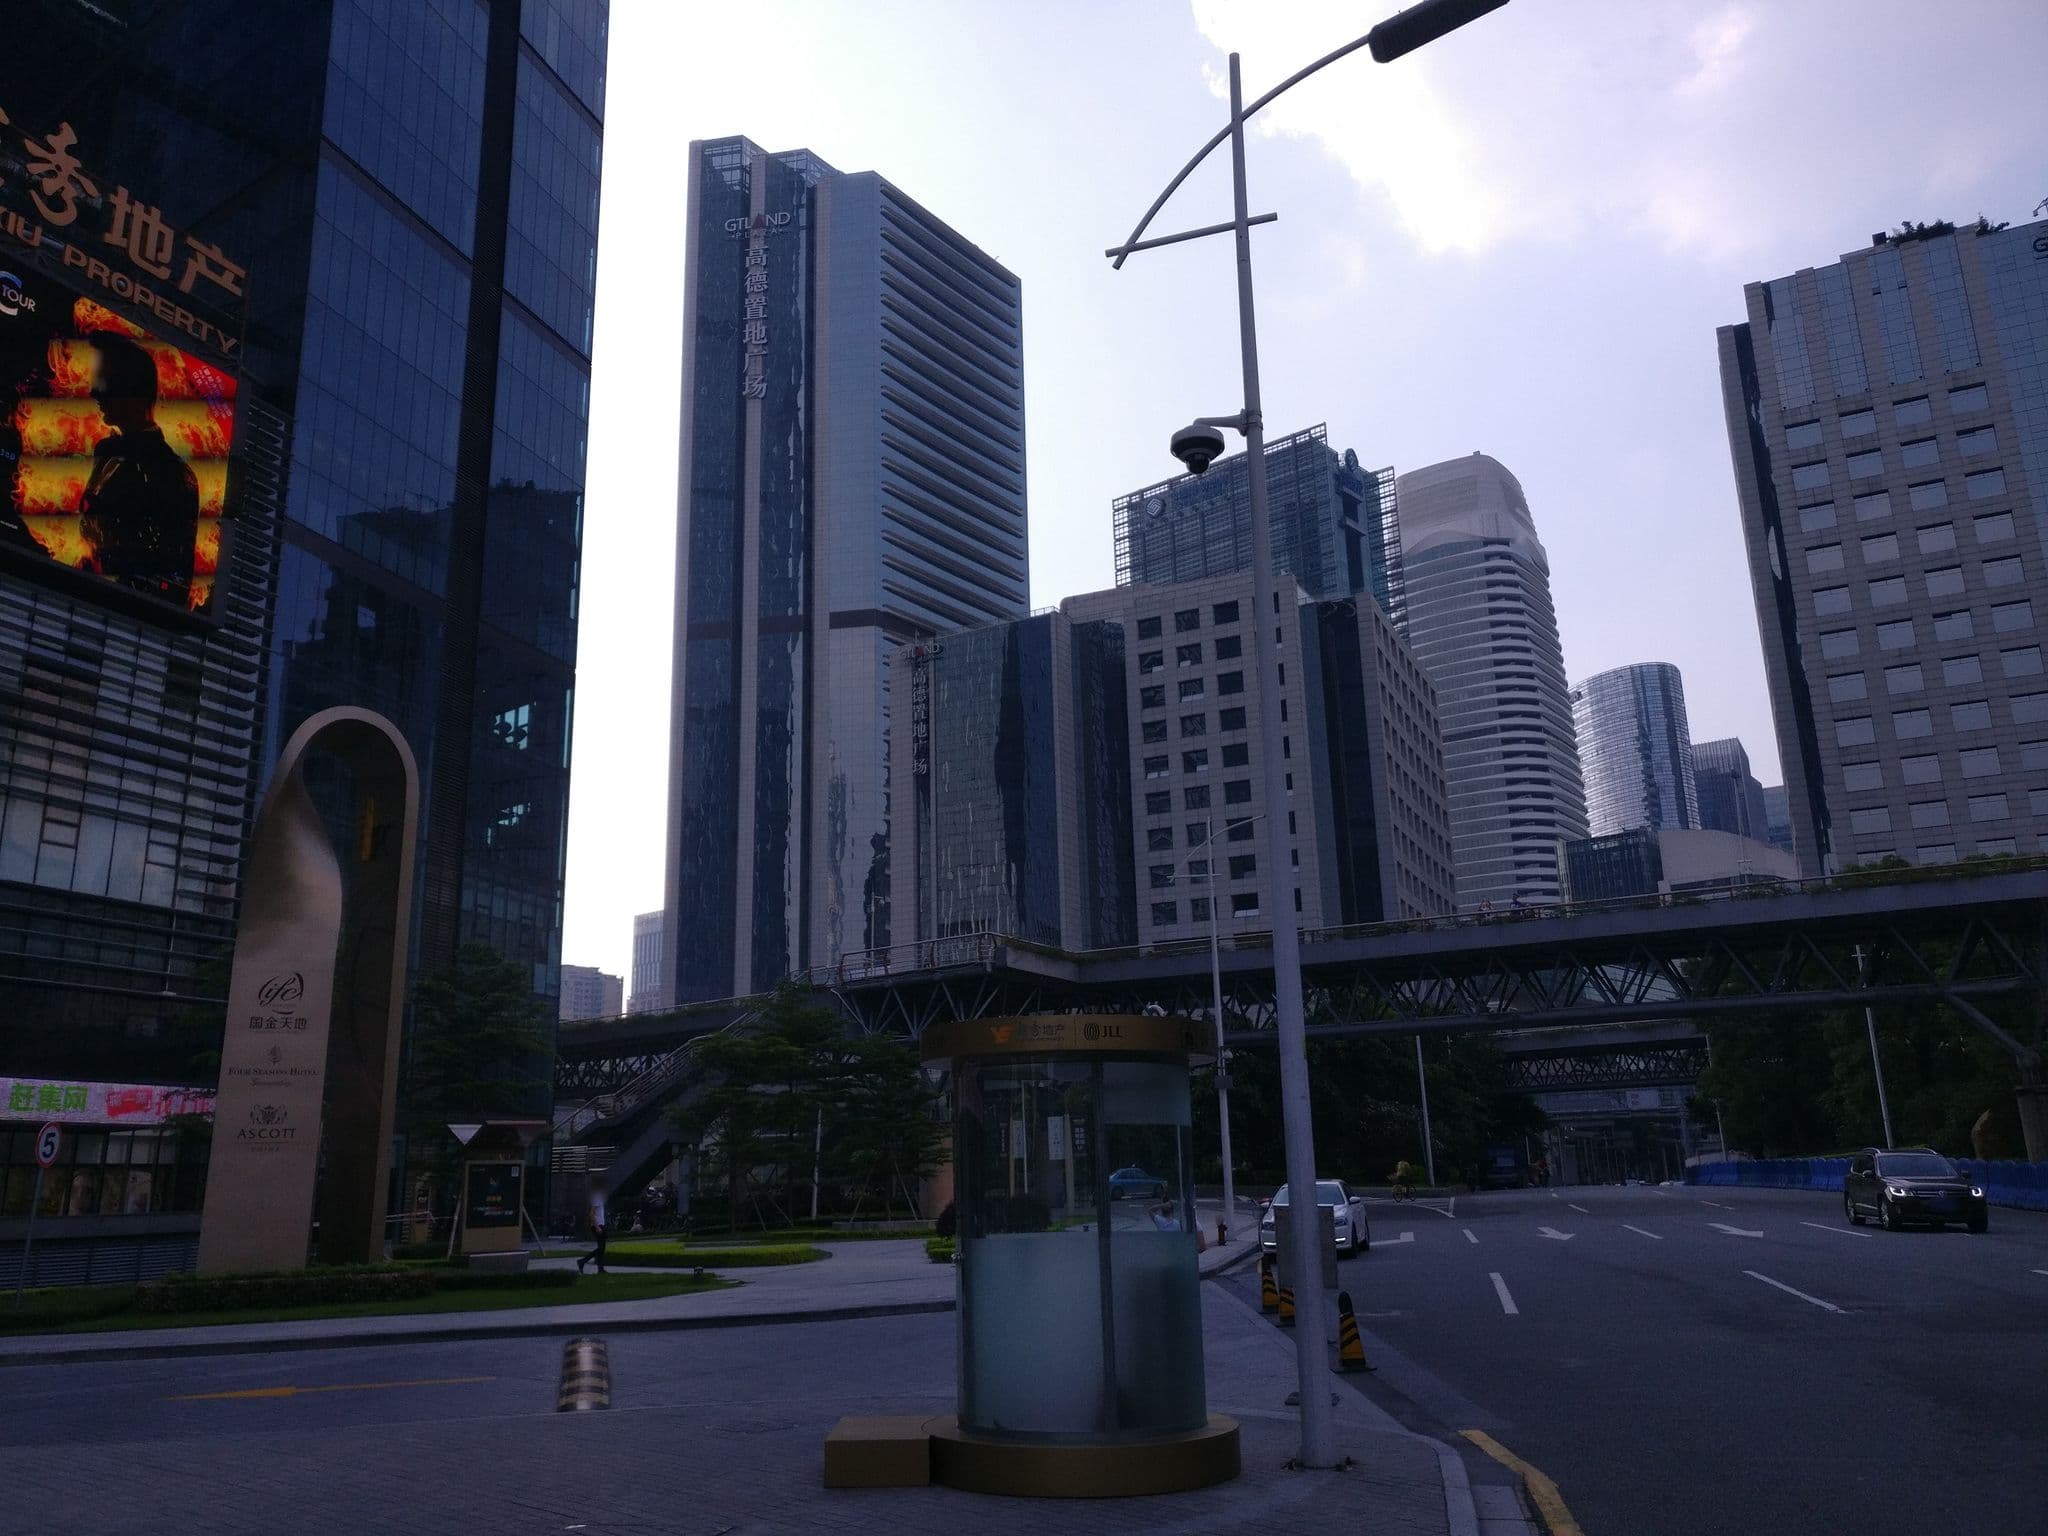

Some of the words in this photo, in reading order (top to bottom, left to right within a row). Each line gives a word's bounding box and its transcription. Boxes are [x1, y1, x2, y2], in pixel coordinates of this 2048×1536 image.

[0, 106, 246, 297] 秀地产
[725, 212, 791, 231] GTLAND
[2, 284, 37, 312] TOUR
[63, 243, 239, 354] PROPERTY
[743, 245, 768, 399] 高德置地广场
[1102, 1025, 1123, 1038] JLL
[42, 1132, 57, 1158] 5
[237, 1128, 296, 1139] ASCOTT
